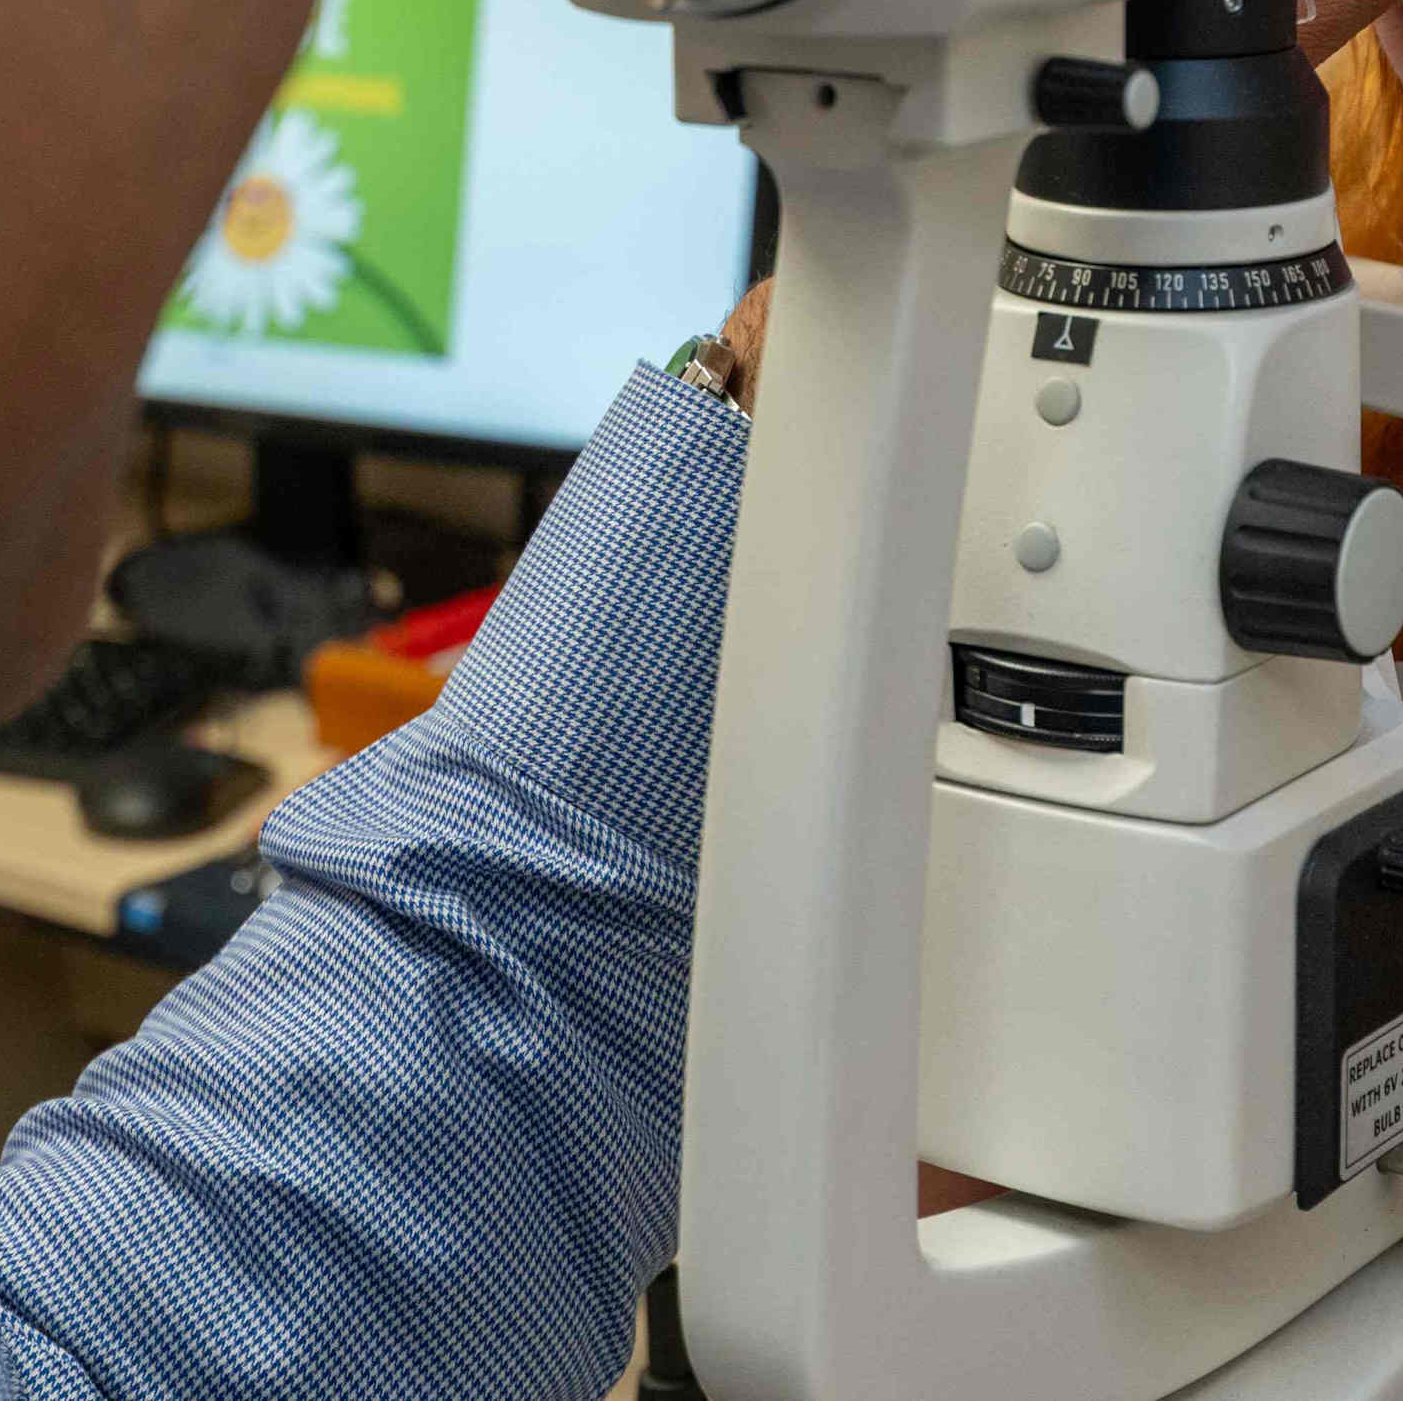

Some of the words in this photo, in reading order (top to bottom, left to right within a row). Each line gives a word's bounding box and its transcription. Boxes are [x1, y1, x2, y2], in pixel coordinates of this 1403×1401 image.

[1037, 262, 1055, 281] 75
[1071, 267, 1092, 287] 90
[1110, 271, 1139, 291] 105
[1155, 273, 1185, 292] 120
[1200, 272, 1230, 291] 135
[1245, 268, 1272, 288] 150
[1282, 264, 1306, 284] 165
[1349, 1040, 1395, 1085] REPLACE
[1351, 1084, 1381, 1117] WITH
[1384, 1072, 1398, 1096] 6V
[1374, 1105, 1401, 1137] BULB
